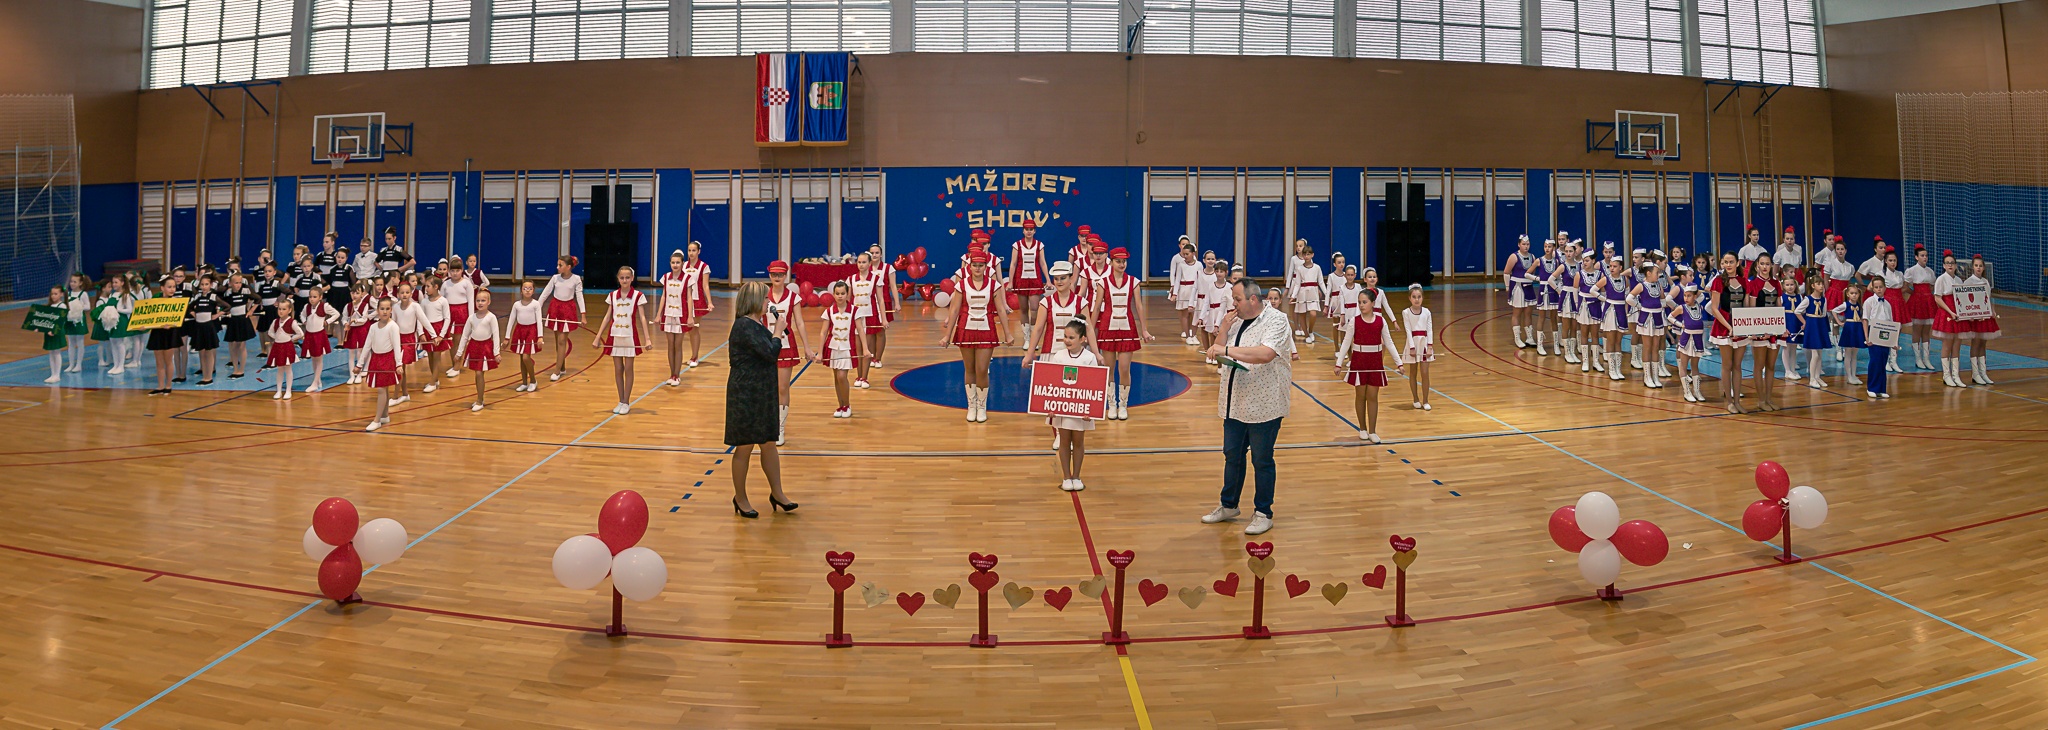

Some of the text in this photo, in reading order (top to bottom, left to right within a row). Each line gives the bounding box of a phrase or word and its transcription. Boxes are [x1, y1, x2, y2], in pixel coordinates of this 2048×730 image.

[945, 169, 1076, 195] MAŽORET
[989, 193, 1011, 208] 14
[967, 209, 1049, 228] SHOW
[133, 302, 185, 316] MAŽORETKINJE
[1733, 316, 1785, 327] DONJI KRALJEVEC
[1033, 383, 1103, 402] MAŽORETKINJE
[1043, 399, 1091, 415] KOTORIBE
